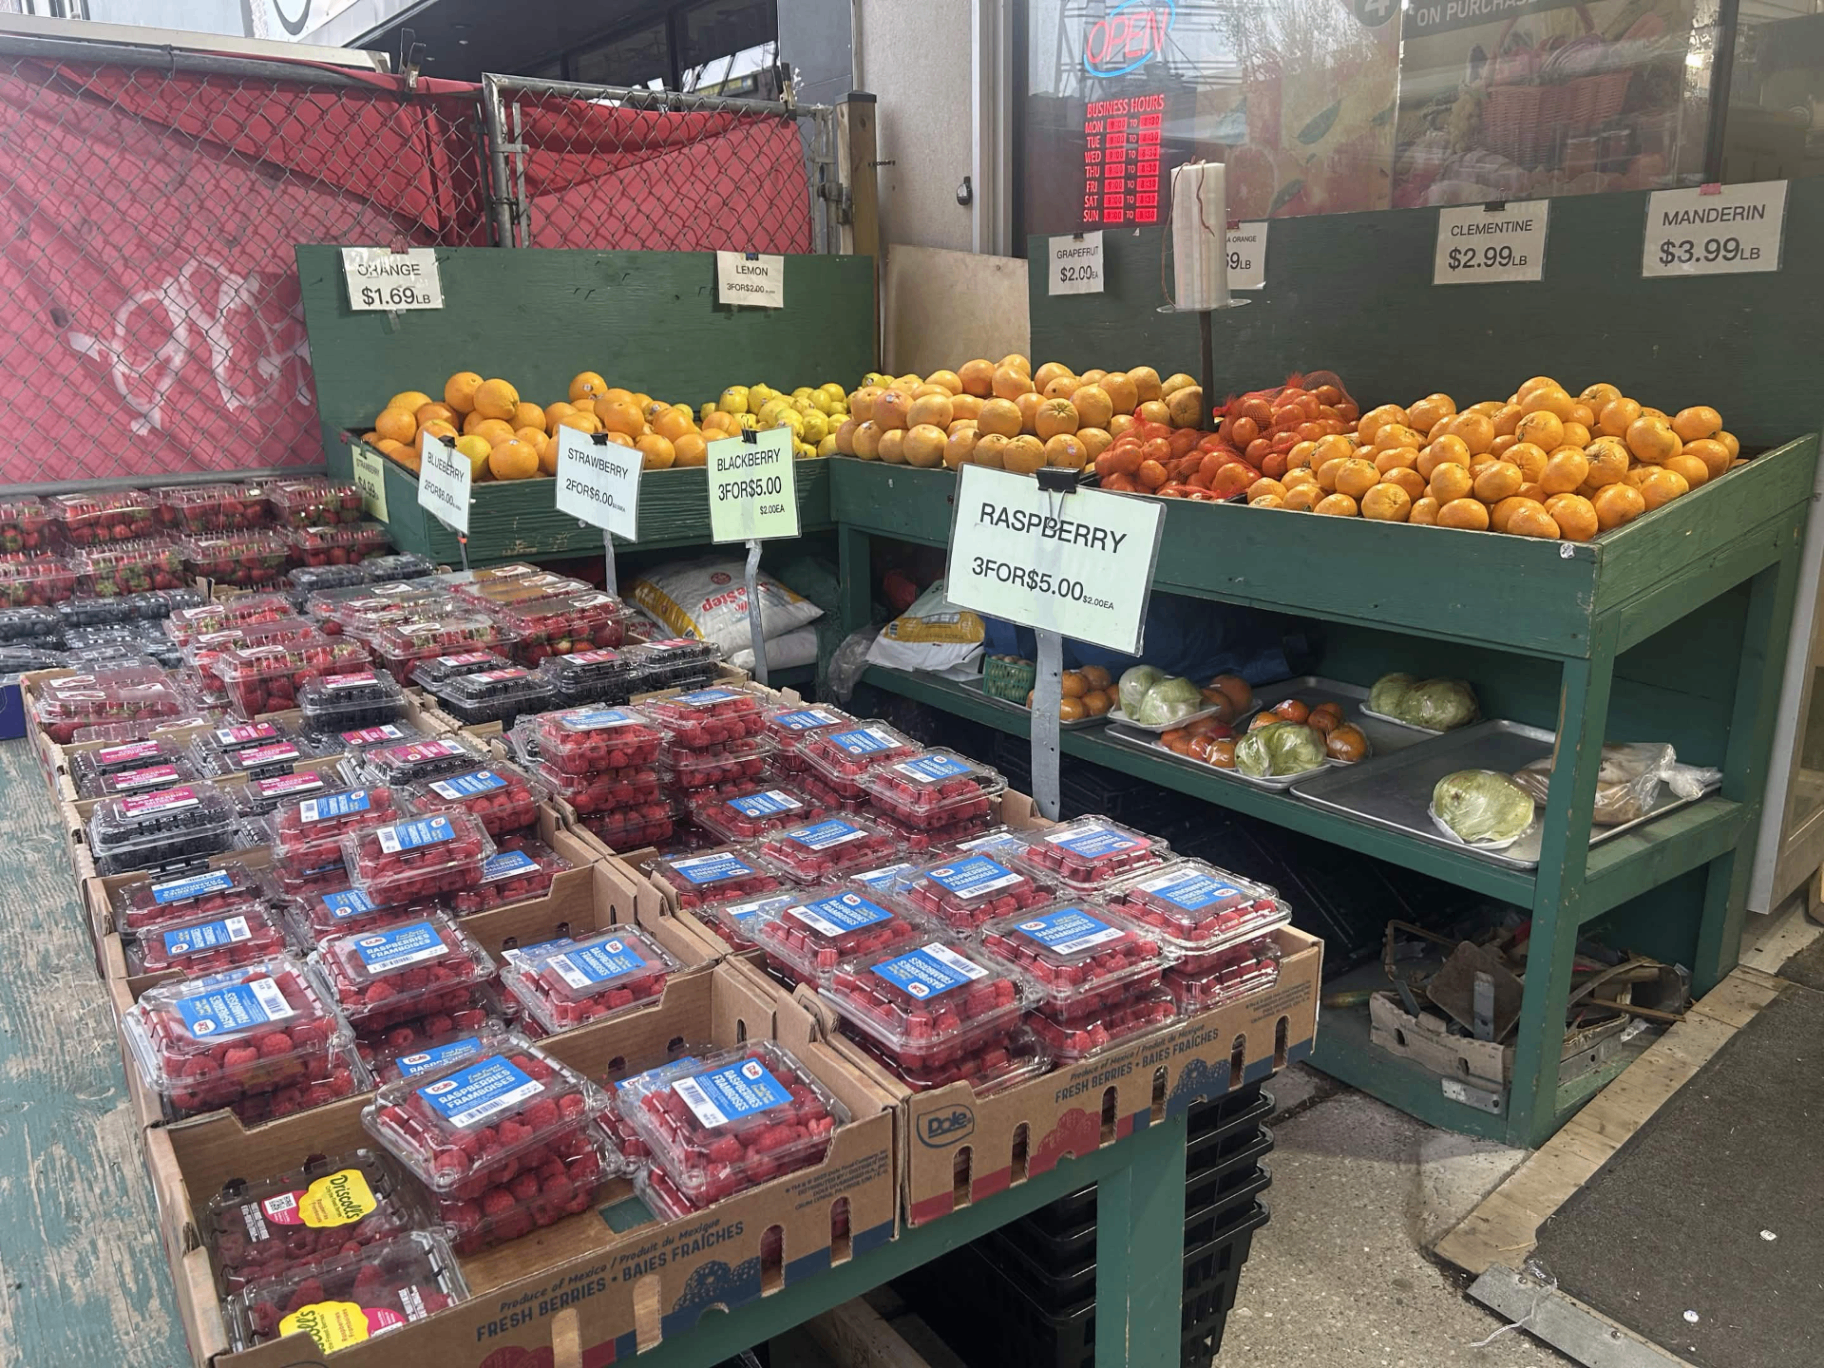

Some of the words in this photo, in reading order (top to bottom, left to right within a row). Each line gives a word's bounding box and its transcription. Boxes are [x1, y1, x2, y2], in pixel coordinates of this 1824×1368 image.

[1417, 4, 1440, 26] ON
[1447, 0, 1536, 20] PURCHA
[1086, 8, 1169, 63] OPEN
[1087, 98, 1128, 118] BUSINESS
[1130, 94, 1164, 113] HOURS
[1085, 120, 1103, 133] MON
[1086, 136, 1100, 148] TUE
[1085, 151, 1101, 163] WED
[1085, 166, 1100, 178] THU
[1127, 165, 1135, 173] TO
[1086, 181, 1098, 193] FRI
[1084, 195, 1098, 208] SAT
[1126, 195, 1134, 203] TO
[1083, 210, 1098, 222] SUN
[1126, 210, 1133, 218] TO
[1451, 219, 1533, 236] CLEMENTINE
[1662, 204, 1766, 226] MANDERIN
[1056, 245, 1098, 259] GRAPEFRUIT
[357, 264, 421, 277] ORANGE
[736, 265, 768, 276] LEMON
[427, 451, 465, 483] BLUEBERRY
[567, 447, 629, 480] STRAWBERRY
[717, 448, 781, 472] BLACKBERRY
[566, 478, 614, 507] 2FOR$6.00
[718, 476, 782, 501] 3FOR$5.00
[979, 502, 1128, 554] RASPBERRY
[971, 555, 1084, 602] 3FOR$5.00
[366, 933, 430, 955] RASPBERRIES
[370, 938, 431, 959] FRAMBOISES
[1055, 1080, 1089, 1103] FRESH
[1091, 1061, 1133, 1088] BERRIES
[1142, 1047, 1170, 1067] BAIES
[1101, 1059, 1108, 1069] of
[438, 1069, 511, 1104] RASPBERRIES
[446, 1076, 516, 1108] FRAMBOISES
[711, 1075, 749, 1111] FRAMBOISES
[723, 1069, 763, 1109] RASPBERRIES
[928, 1111, 967, 1139] Dole
[329, 1174, 364, 1219] Driscoll's
[499, 1288, 548, 1313] Produce
[551, 1278, 565, 1292] of
[568, 1263, 607, 1285] Mexico
[619, 1242, 659, 1265] Produit
[662, 1236, 675, 1247] du
[678, 1219, 721, 1240] Mexique
[477, 1310, 533, 1342] FRESH
[538, 1277, 607, 1317] BERRIES
[622, 1252, 668, 1282] BAIES
[671, 1221, 744, 1262] FRAÎCHES
[335, 1312, 348, 1342] Raspberries
